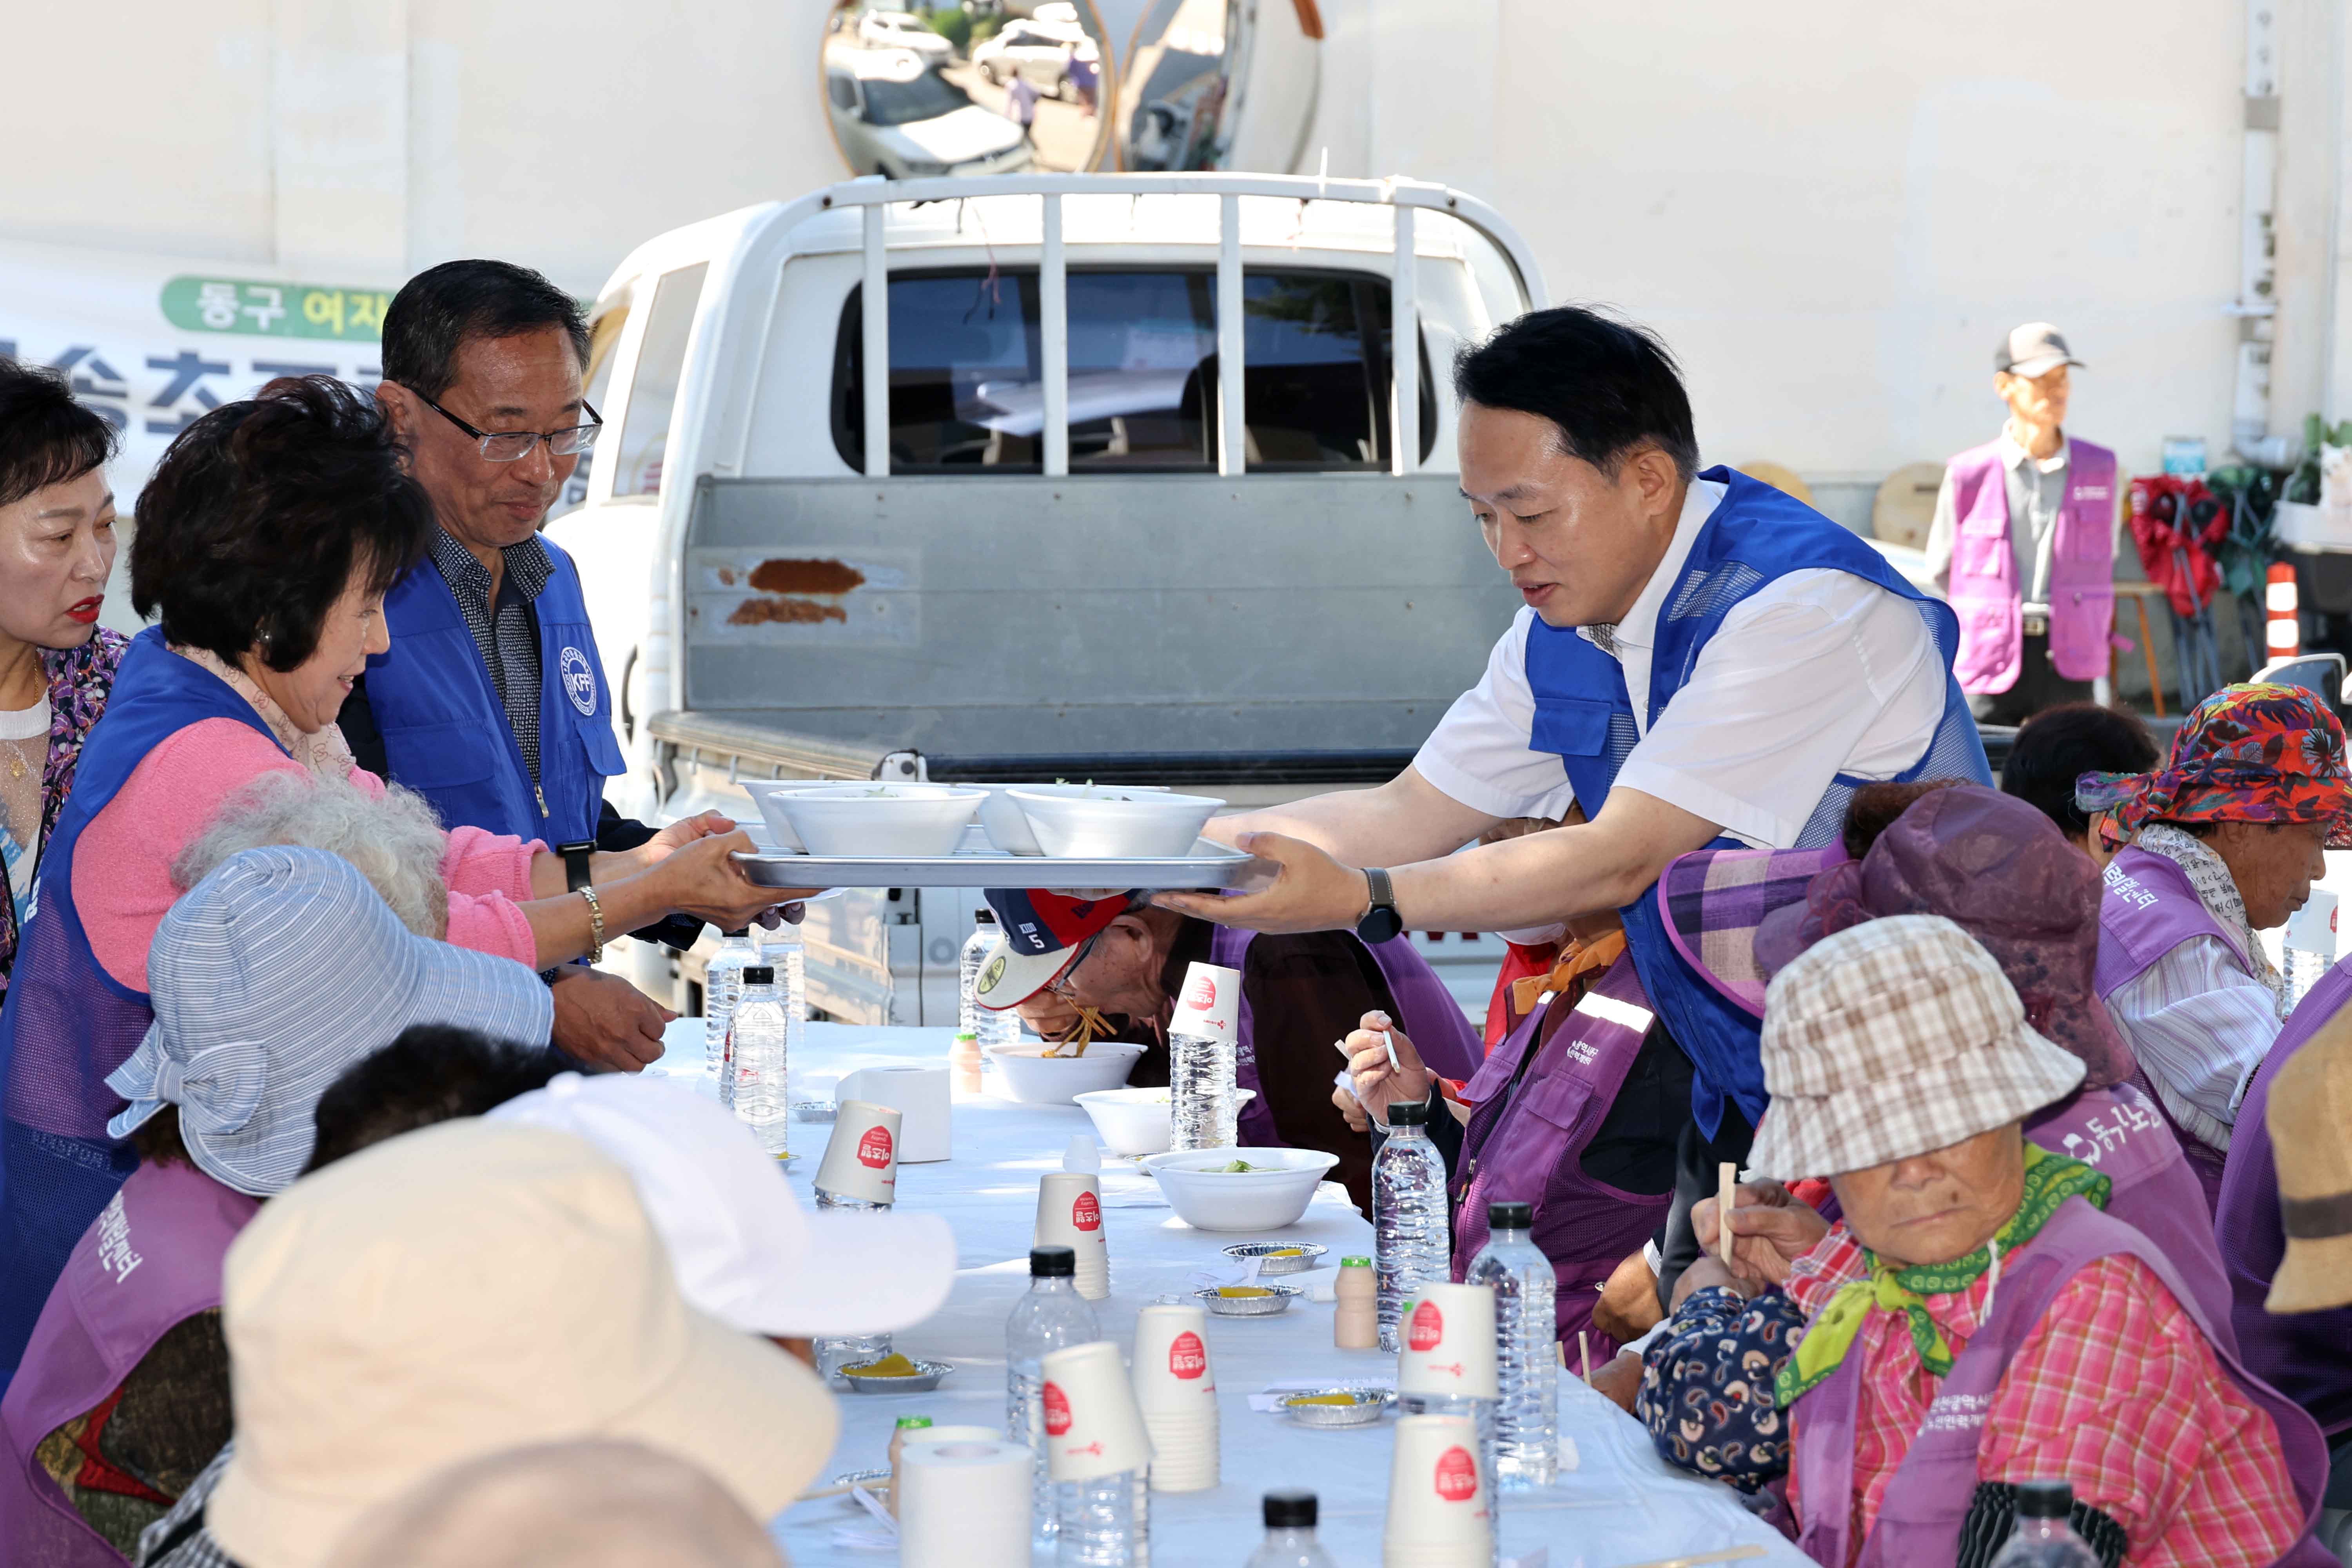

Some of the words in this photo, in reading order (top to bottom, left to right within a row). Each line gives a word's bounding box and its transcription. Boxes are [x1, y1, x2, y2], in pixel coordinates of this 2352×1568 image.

[197, 281, 286, 330] 동구
[570, 673, 590, 691] KFF
[1028, 934, 1045, 949] 5
[861, 1144, 890, 1161] 이츠웰
[1075, 1210, 1099, 1223] 이츠웰
[1930, 1393, 1993, 1414] 인천광역시
